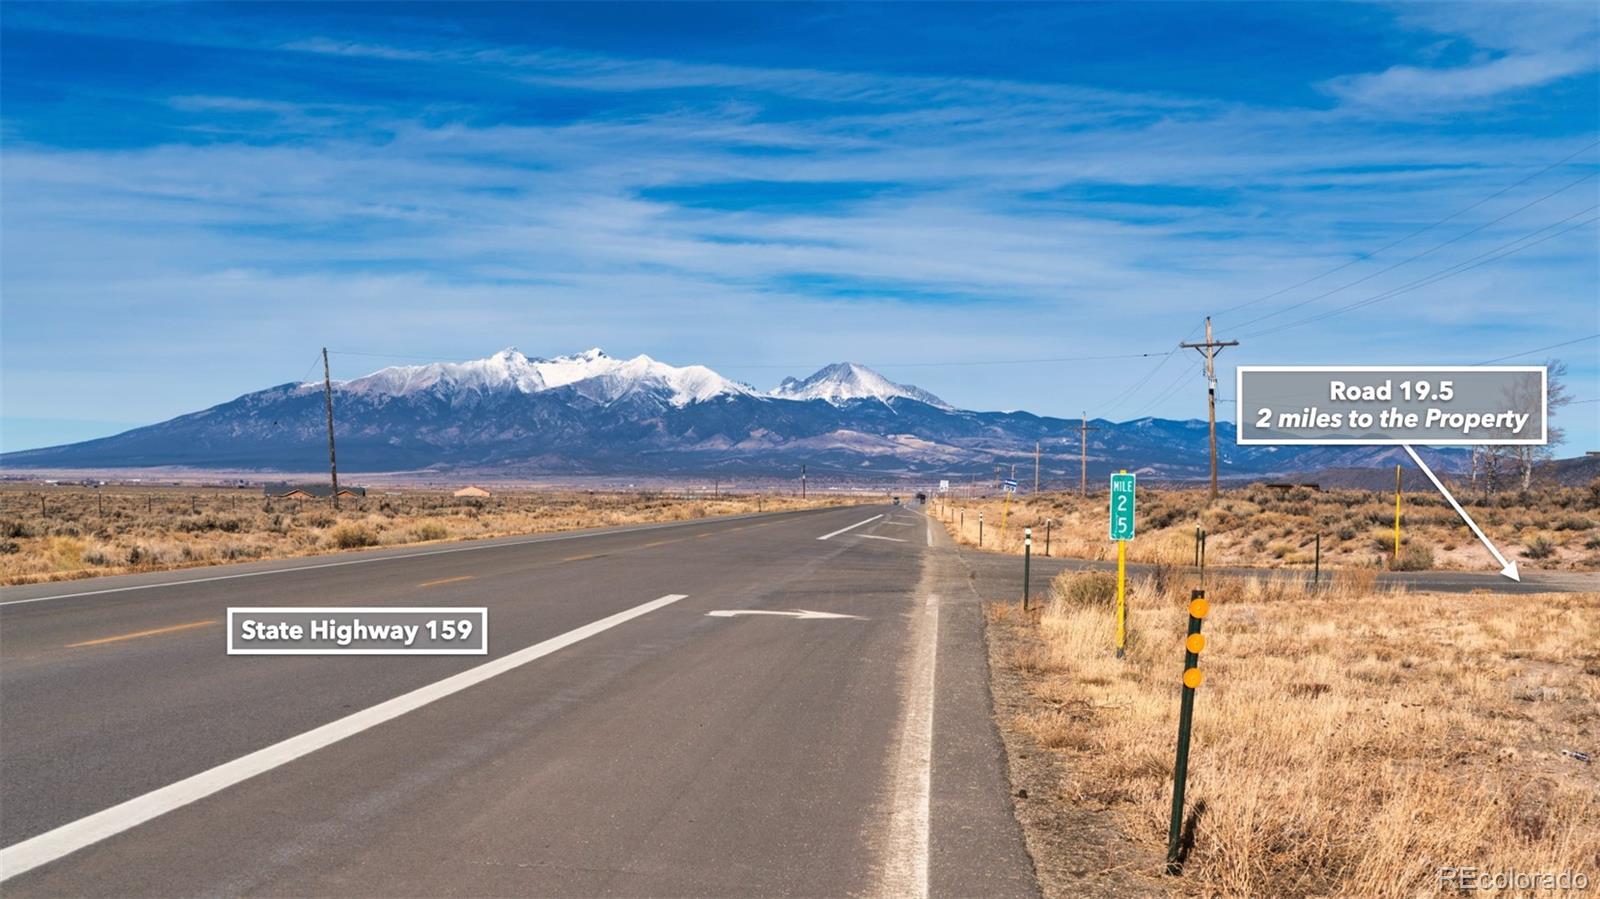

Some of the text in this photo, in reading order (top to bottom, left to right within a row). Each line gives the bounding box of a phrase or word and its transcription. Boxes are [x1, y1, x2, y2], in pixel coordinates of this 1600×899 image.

[1113, 481, 1133, 492] MILE
[1117, 495, 1127, 511] 2
[1118, 517, 1127, 533] 5
